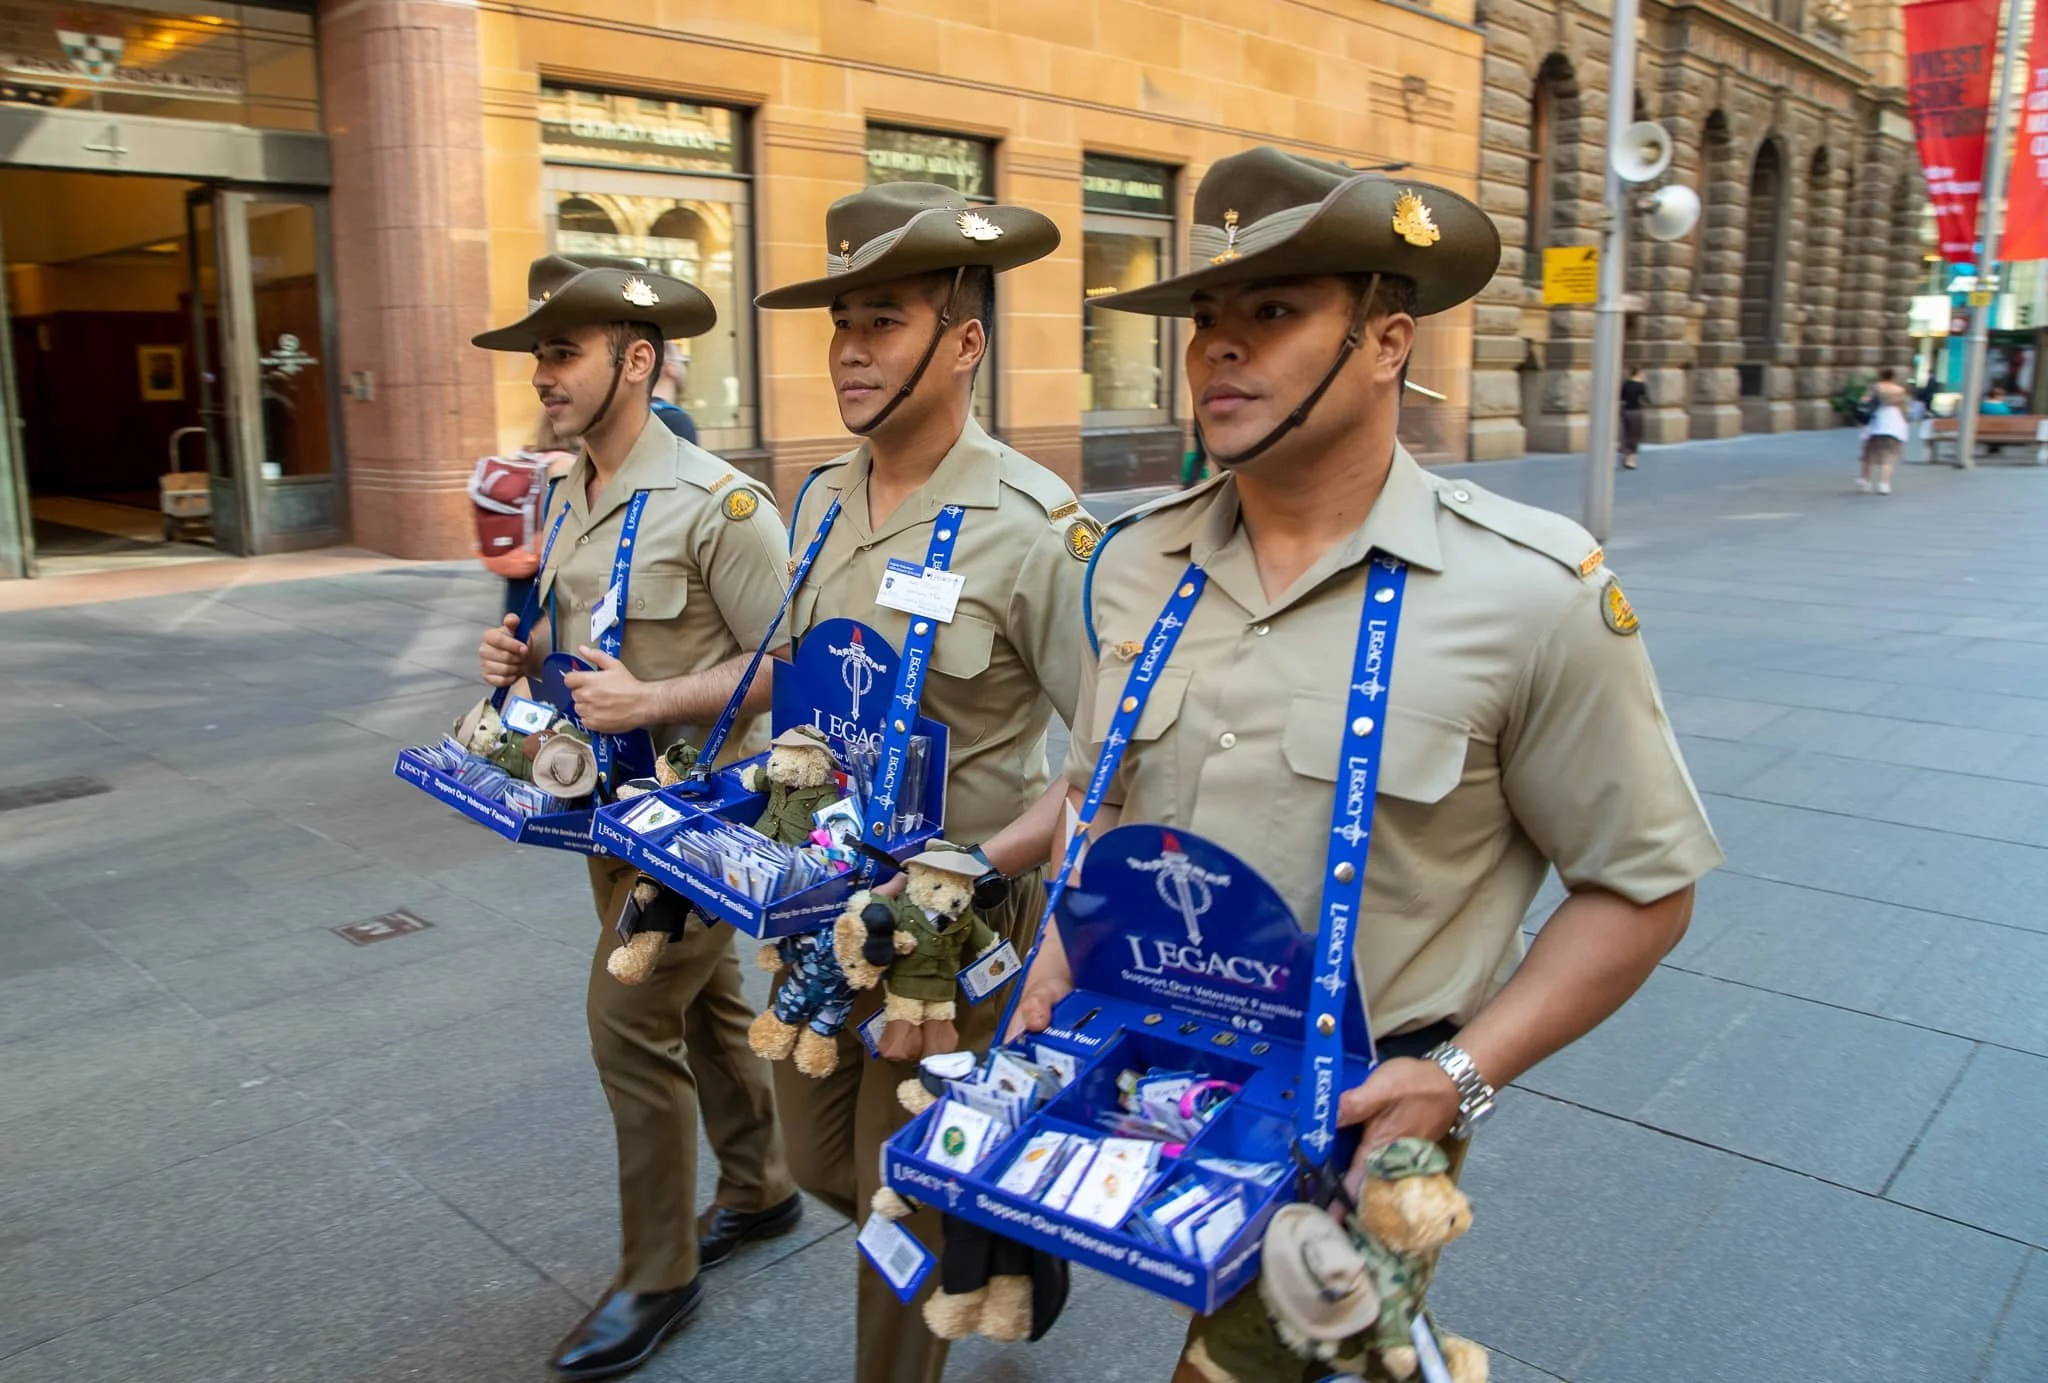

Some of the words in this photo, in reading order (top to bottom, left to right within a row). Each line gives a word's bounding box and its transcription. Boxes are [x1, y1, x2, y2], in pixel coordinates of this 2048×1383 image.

[83, 124, 128, 165] 4
[905, 648, 923, 692] LEGACY
[1136, 634, 1168, 682] LEGACY
[1365, 619, 1387, 673] LEGACY
[813, 708, 885, 755] LEGAC
[884, 746, 901, 791] LEGACY
[1346, 756, 1368, 816] LEGACY
[434, 778, 456, 796] Support
[456, 790, 467, 802] Our
[491, 809, 516, 829] Families
[598, 822, 625, 844] LEGACY
[642, 847, 672, 873] Support
[671, 865, 687, 881] Our
[719, 893, 755, 920] Families
[1327, 902, 1349, 966] LEGACY
[1125, 934, 1280, 990] LEGACY
[1168, 979, 1192, 994] Our
[1043, 1025, 1074, 1040] hank
[1073, 1032, 1102, 1047] You!
[1313, 1056, 1334, 1121] LEGACY
[976, 1193, 1032, 1227] Support
[1031, 1215, 1061, 1236] Our
[1128, 1249, 1196, 1288] Families
